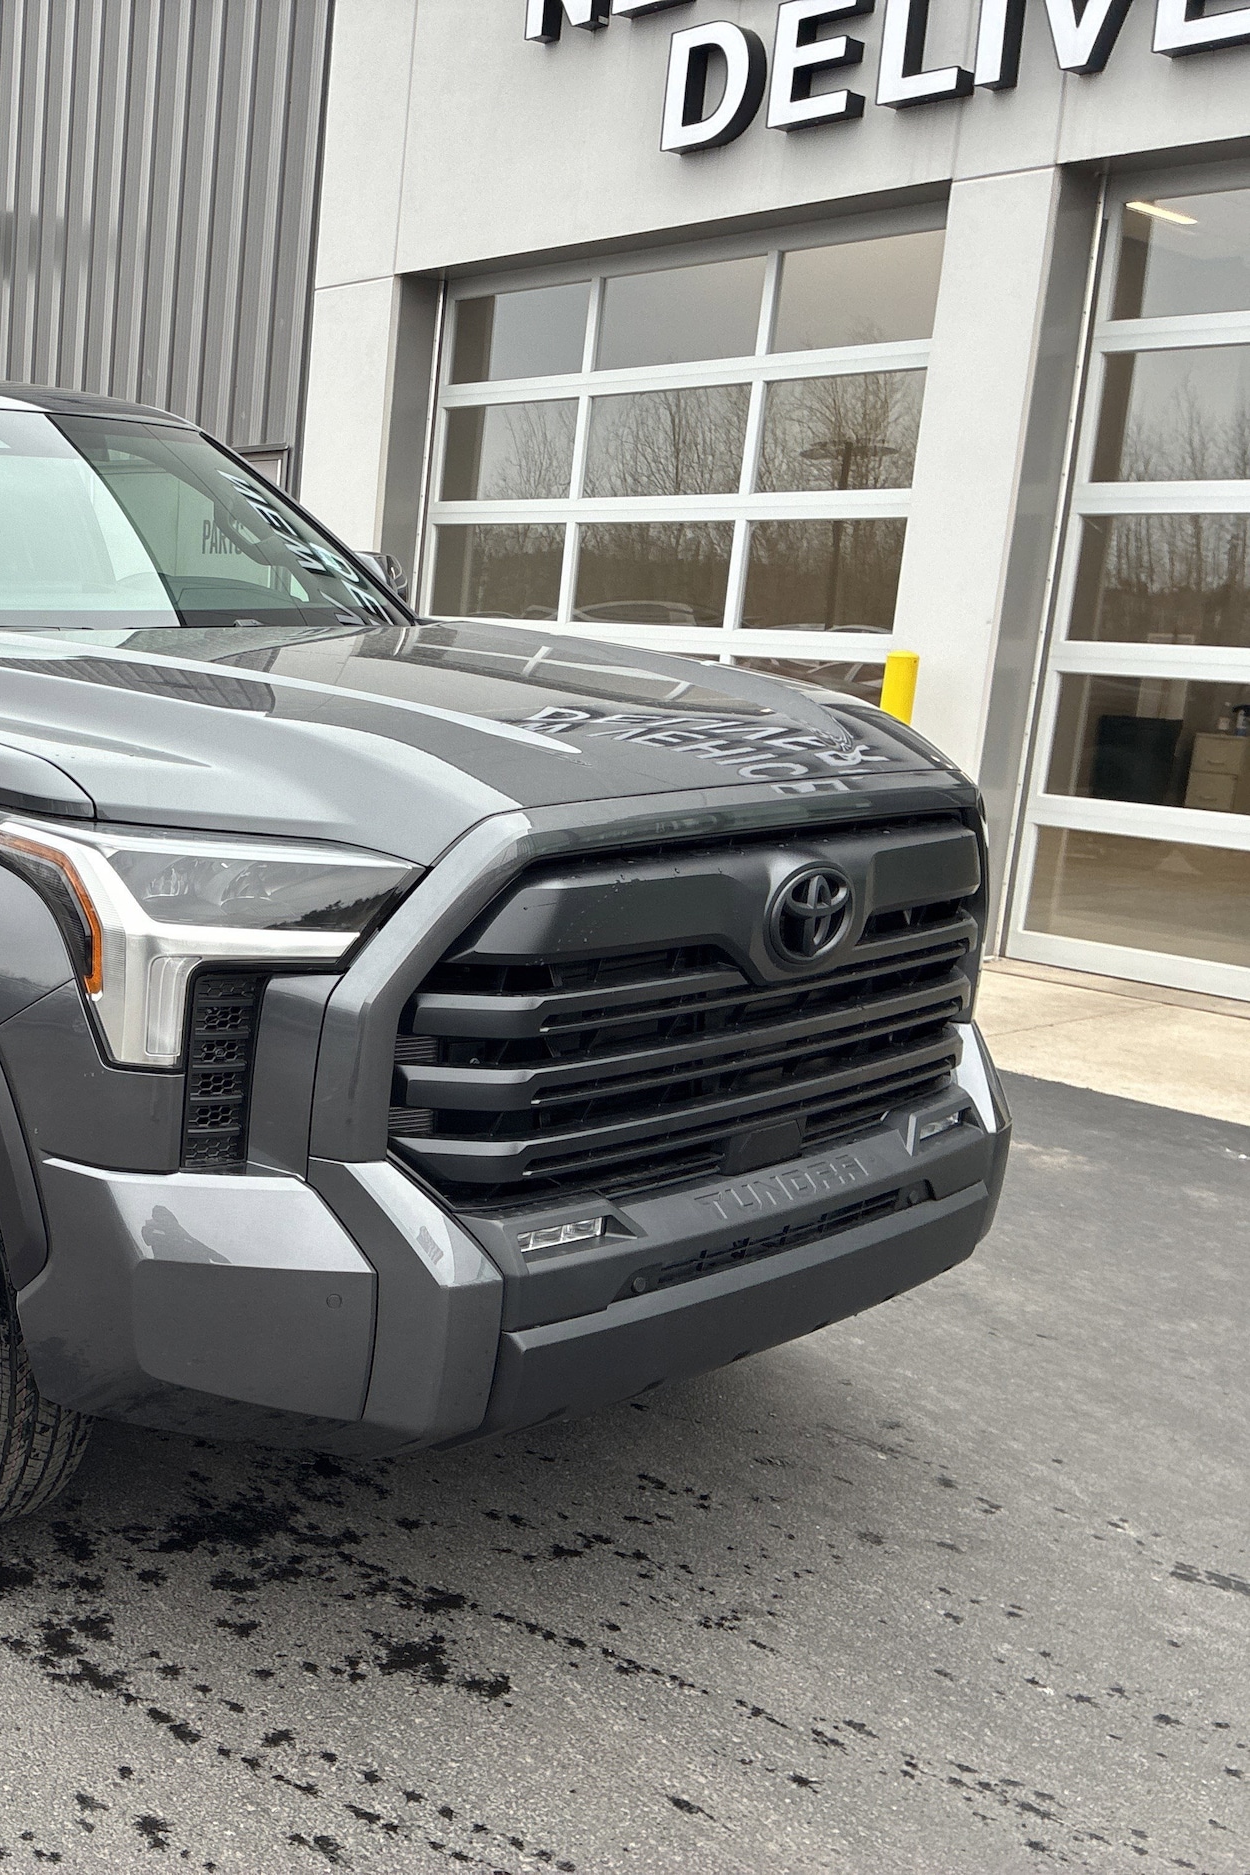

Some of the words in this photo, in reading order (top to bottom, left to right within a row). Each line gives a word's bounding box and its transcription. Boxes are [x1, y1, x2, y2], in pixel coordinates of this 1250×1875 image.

[661, 0, 1250, 153] DELIV
[202, 520, 242, 554] PAR
[693, 1154, 869, 1220] TUNDRA
